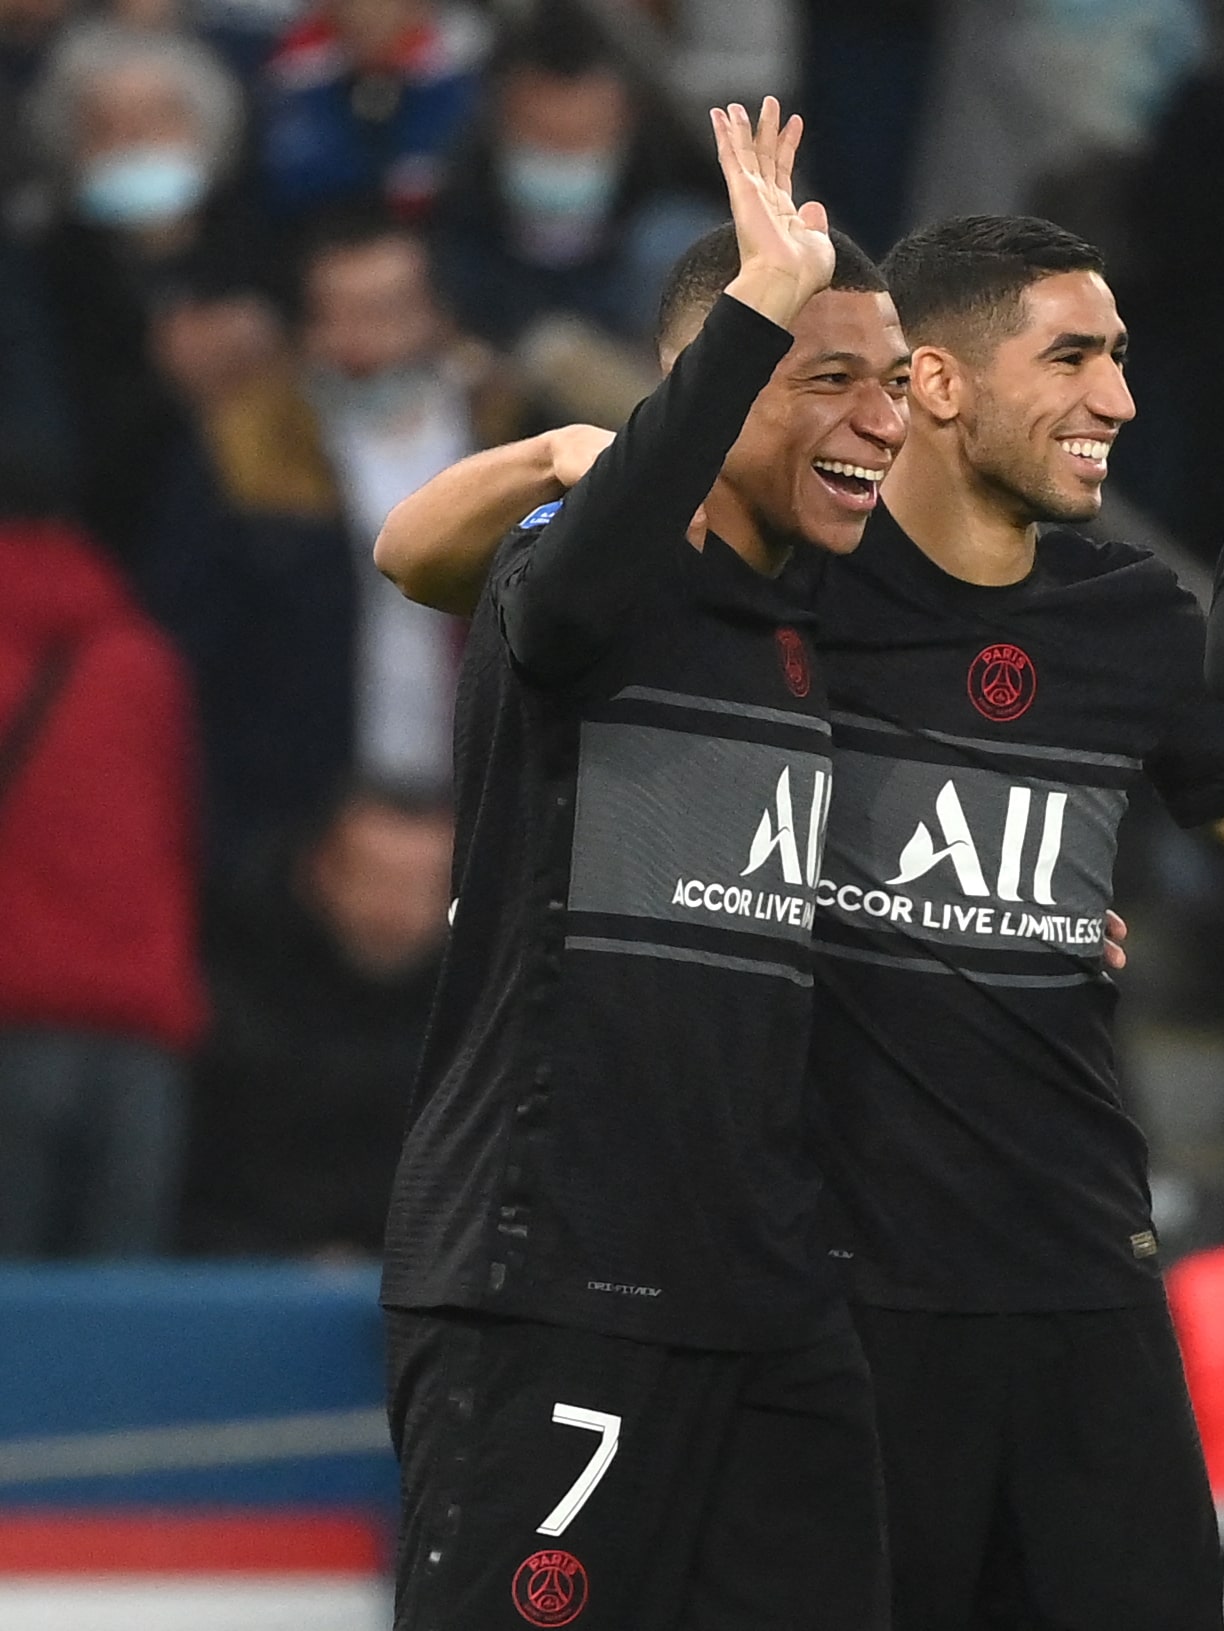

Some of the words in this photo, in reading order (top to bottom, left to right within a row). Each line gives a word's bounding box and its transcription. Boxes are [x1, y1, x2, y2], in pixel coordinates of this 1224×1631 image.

[981, 648, 1027, 670] PARIS
[671, 877, 752, 916] ACCOR
[754, 892, 803, 925] LIVE
[816, 879, 913, 923] CCOR
[923, 900, 993, 935] LIVE
[1000, 910, 1104, 945] LIMITLESS
[536, 1402, 622, 1537] 7
[528, 1554, 578, 1577] PARIS
